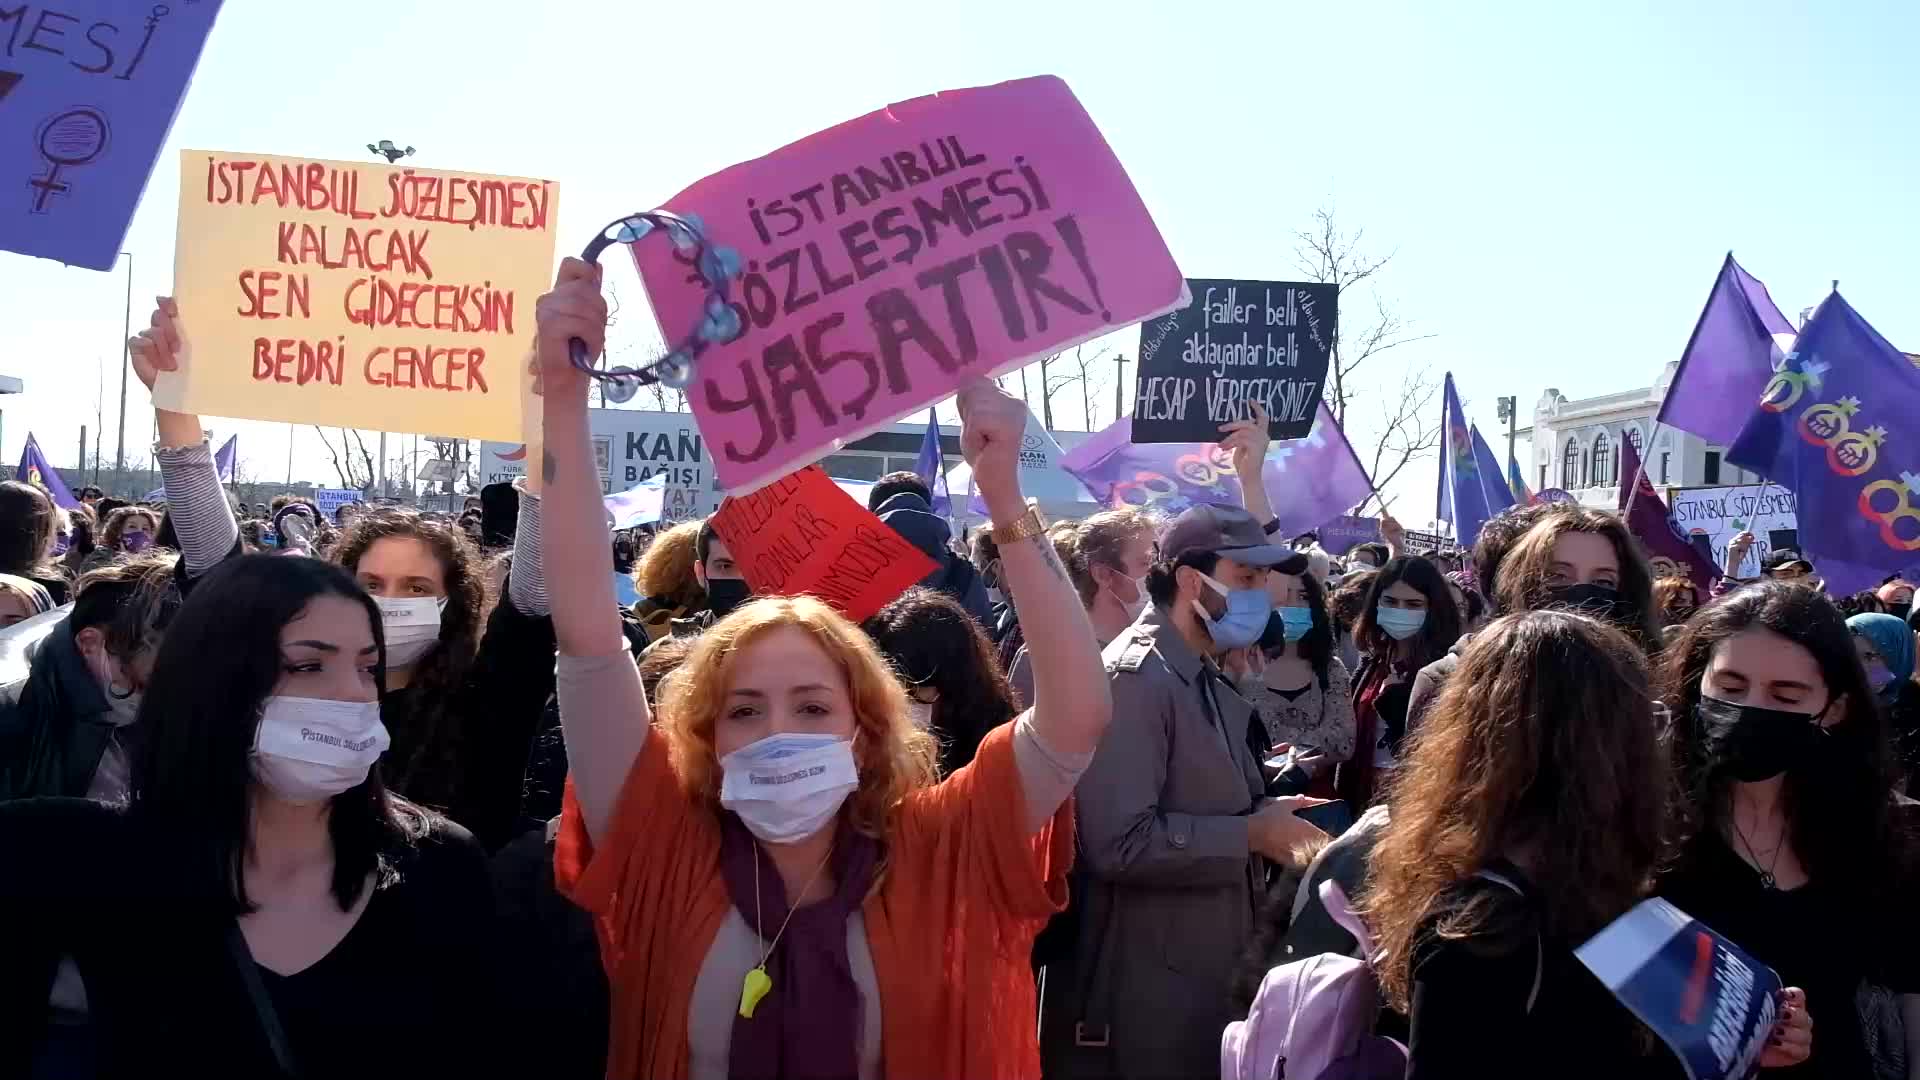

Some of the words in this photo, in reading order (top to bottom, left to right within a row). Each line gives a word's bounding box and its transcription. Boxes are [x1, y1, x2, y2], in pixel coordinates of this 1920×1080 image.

[207, 157, 376, 220] İSTANBUL
[380, 169, 550, 231] SÖZLEŞMESİ
[747, 135, 986, 246] İSTANBUL
[277, 221, 432, 280] KALACAK
[237, 270, 310, 319] SEN
[344, 274, 514, 334] GİDECEKSİN
[1203, 287, 1257, 329] failler
[1266, 288, 1298, 326] belli
[252, 335, 345, 386] BEDRİ
[363, 345, 489, 394] GENCER
[704, 213, 1112, 464] YAŞATIR!
[1182, 332, 1264, 378] aklayanlar
[1266, 333, 1299, 367] belli
[1133, 376, 1197, 421] HESAP
[626, 431, 701, 463] KAN
